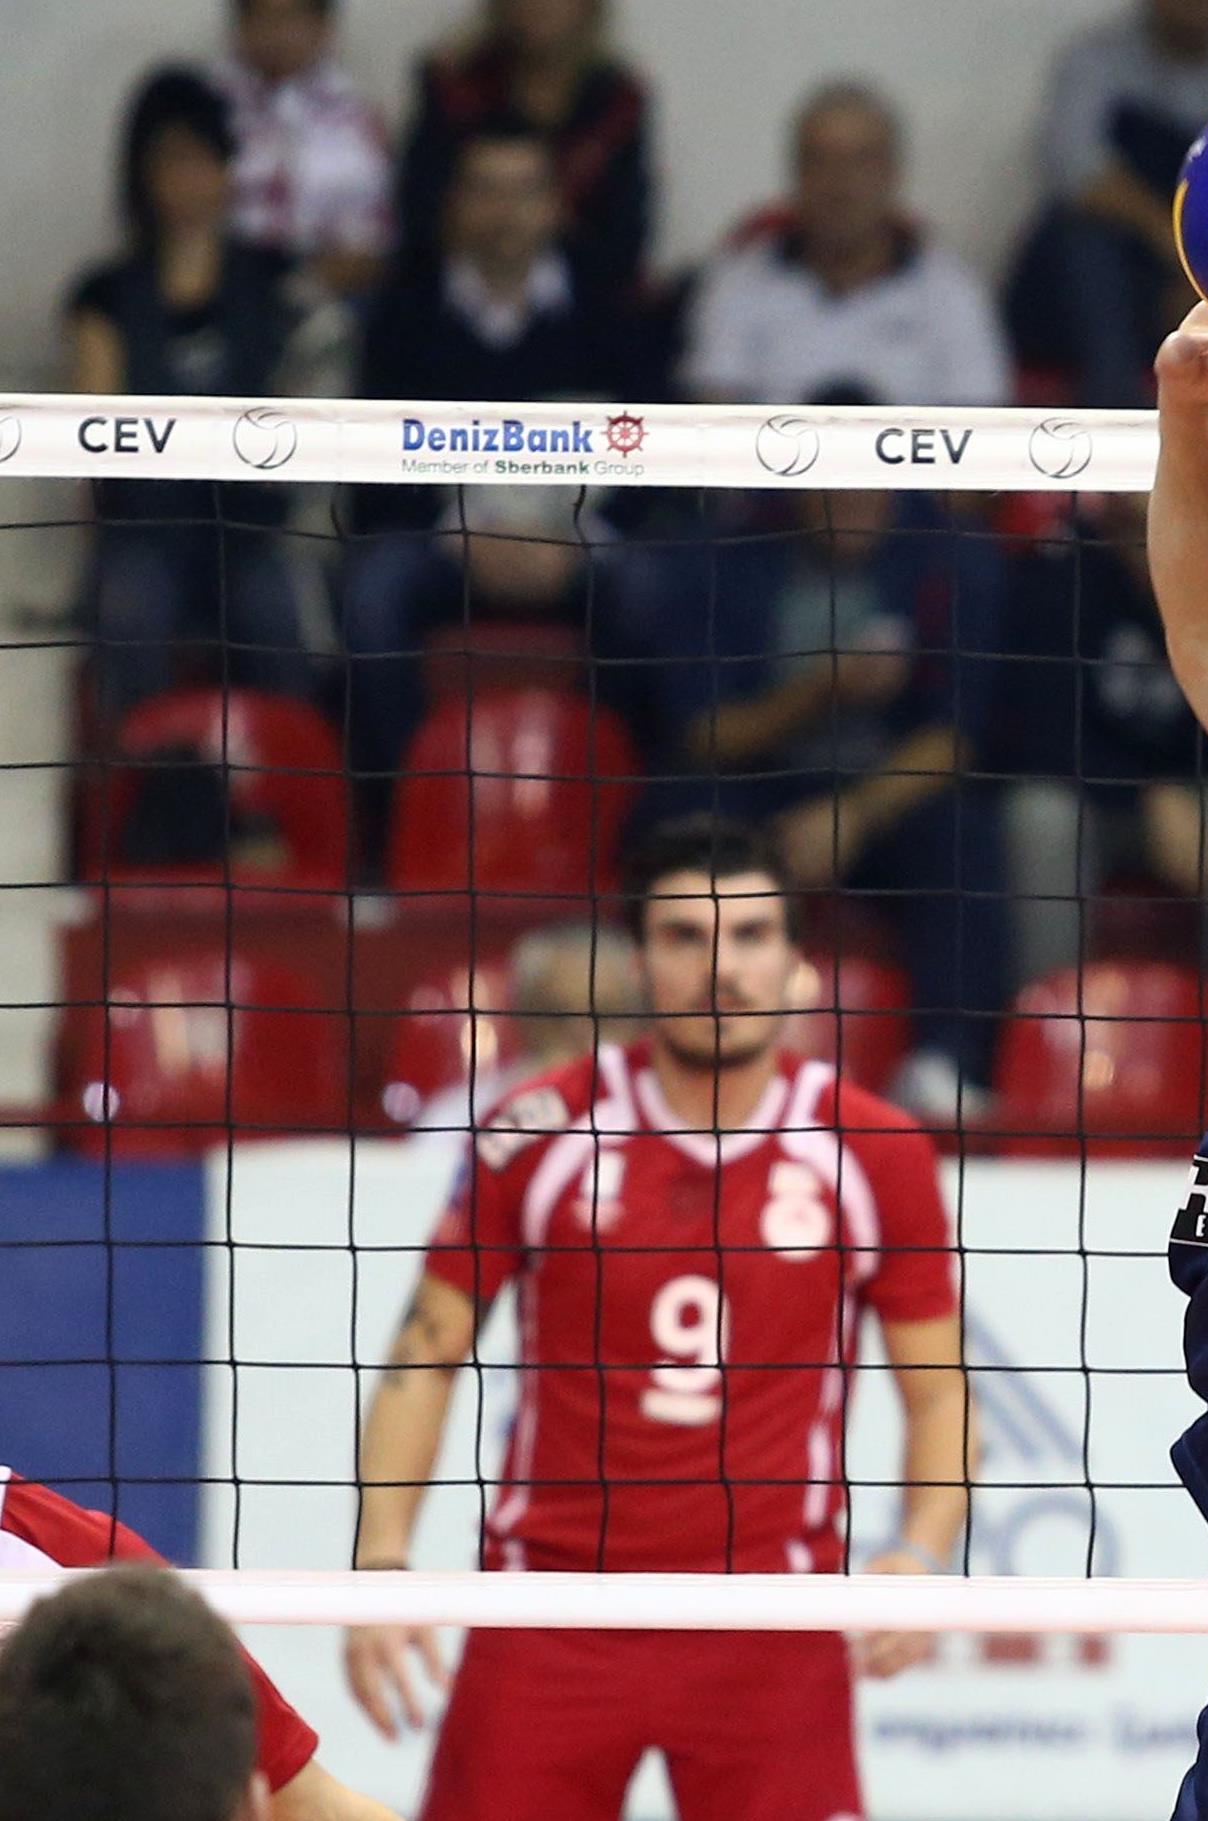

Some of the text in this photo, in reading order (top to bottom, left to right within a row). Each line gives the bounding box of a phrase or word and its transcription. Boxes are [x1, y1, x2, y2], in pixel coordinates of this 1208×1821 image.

[78, 417, 177, 454] CEV
[402, 418, 594, 453] DenizBank
[875, 427, 972, 465] CEV
[402, 459, 645, 477] Member of Sberbank Group
[650, 1274, 731, 1394] 9
